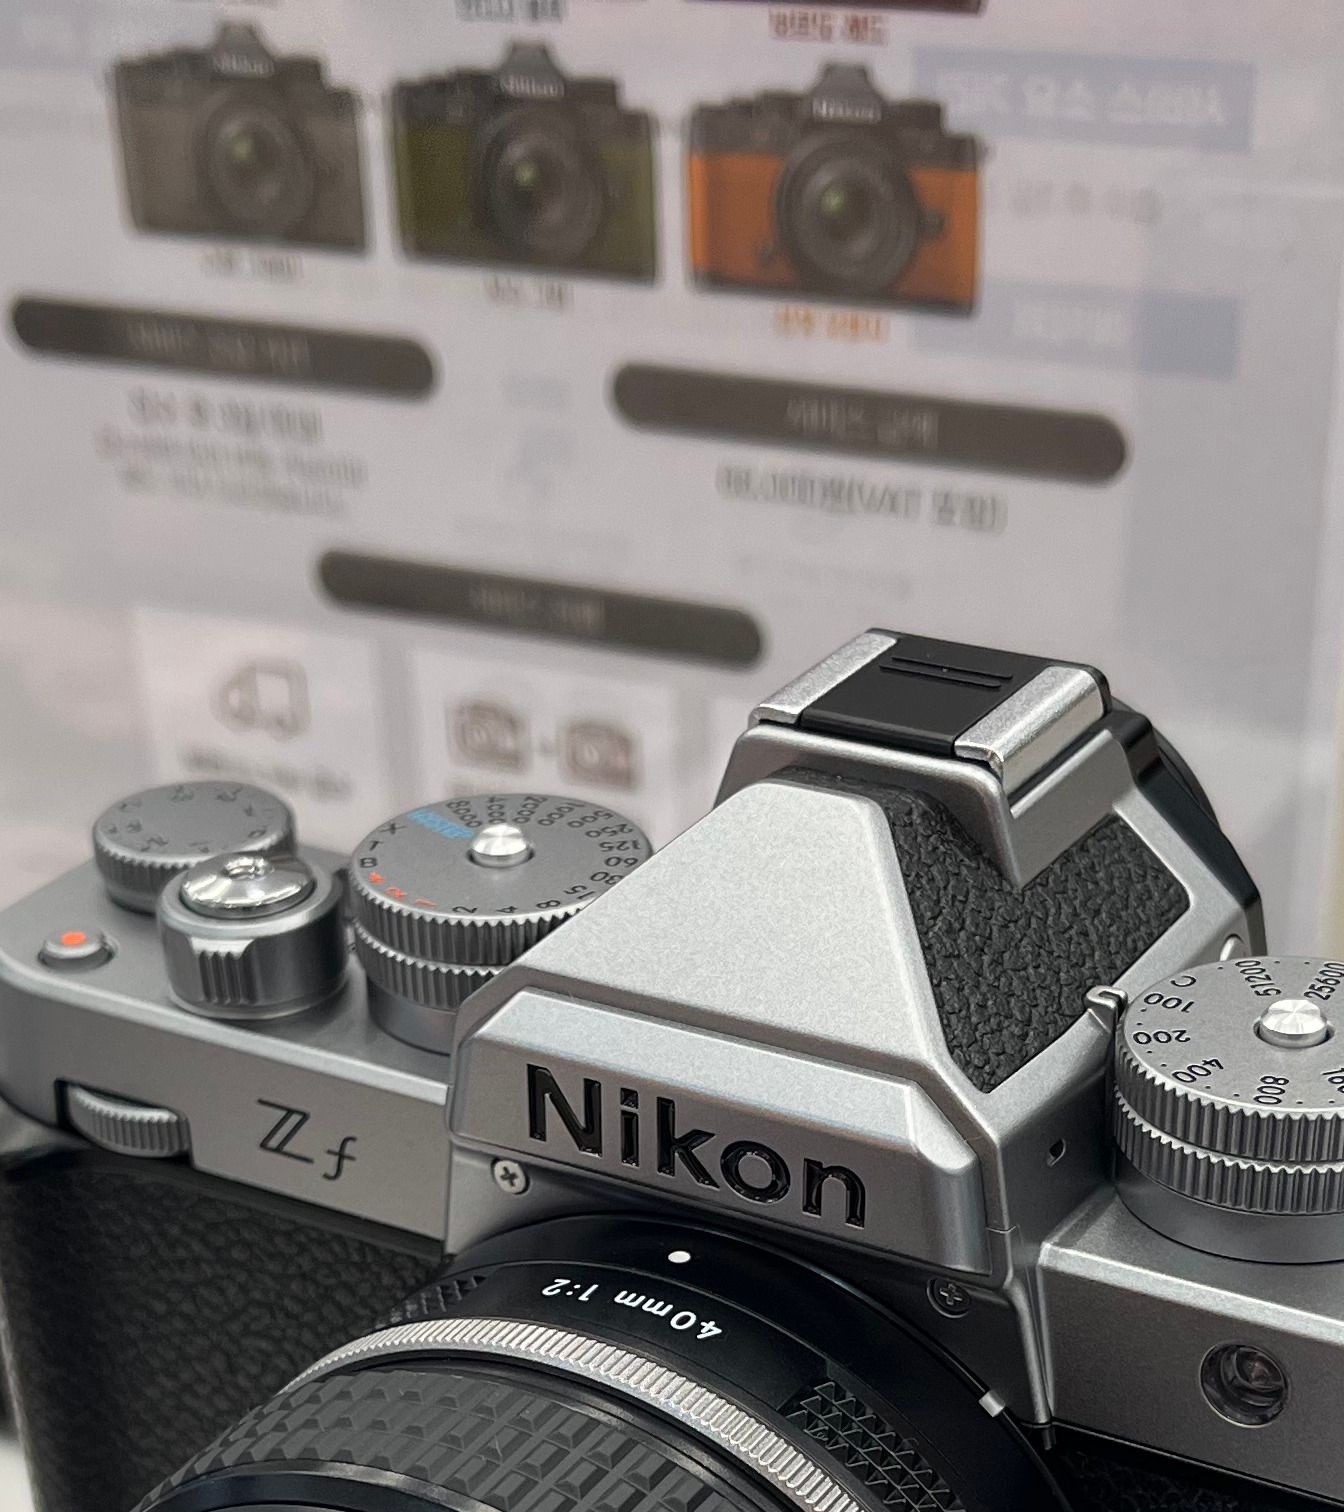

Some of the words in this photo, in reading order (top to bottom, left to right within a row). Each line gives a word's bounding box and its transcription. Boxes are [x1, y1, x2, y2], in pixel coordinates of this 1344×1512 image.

[538, 801, 585, 826] 1000
[567, 809, 613, 829] 500
[586, 823, 634, 839] 250
[599, 839, 641, 851] 125
[360, 857, 379, 868] B
[604, 856, 638, 868] 60
[590, 871, 624, 887] 30
[564, 884, 596, 900] 15
[452, 905, 477, 914] 2
[496, 905, 518, 914] 4
[536, 900, 561, 909] 8
[1171, 973, 1197, 988] C
[1235, 958, 1282, 997] 51200
[1144, 992, 1195, 1013] 100
[1133, 1029, 1191, 1045] 200
[1172, 1057, 1225, 1084] 400
[1254, 1075, 1289, 1106] 800
[527, 1063, 866, 1228] Nikon
[542, 1278, 595, 1302] 1:2
[614, 1288, 723, 1341] 40mm
